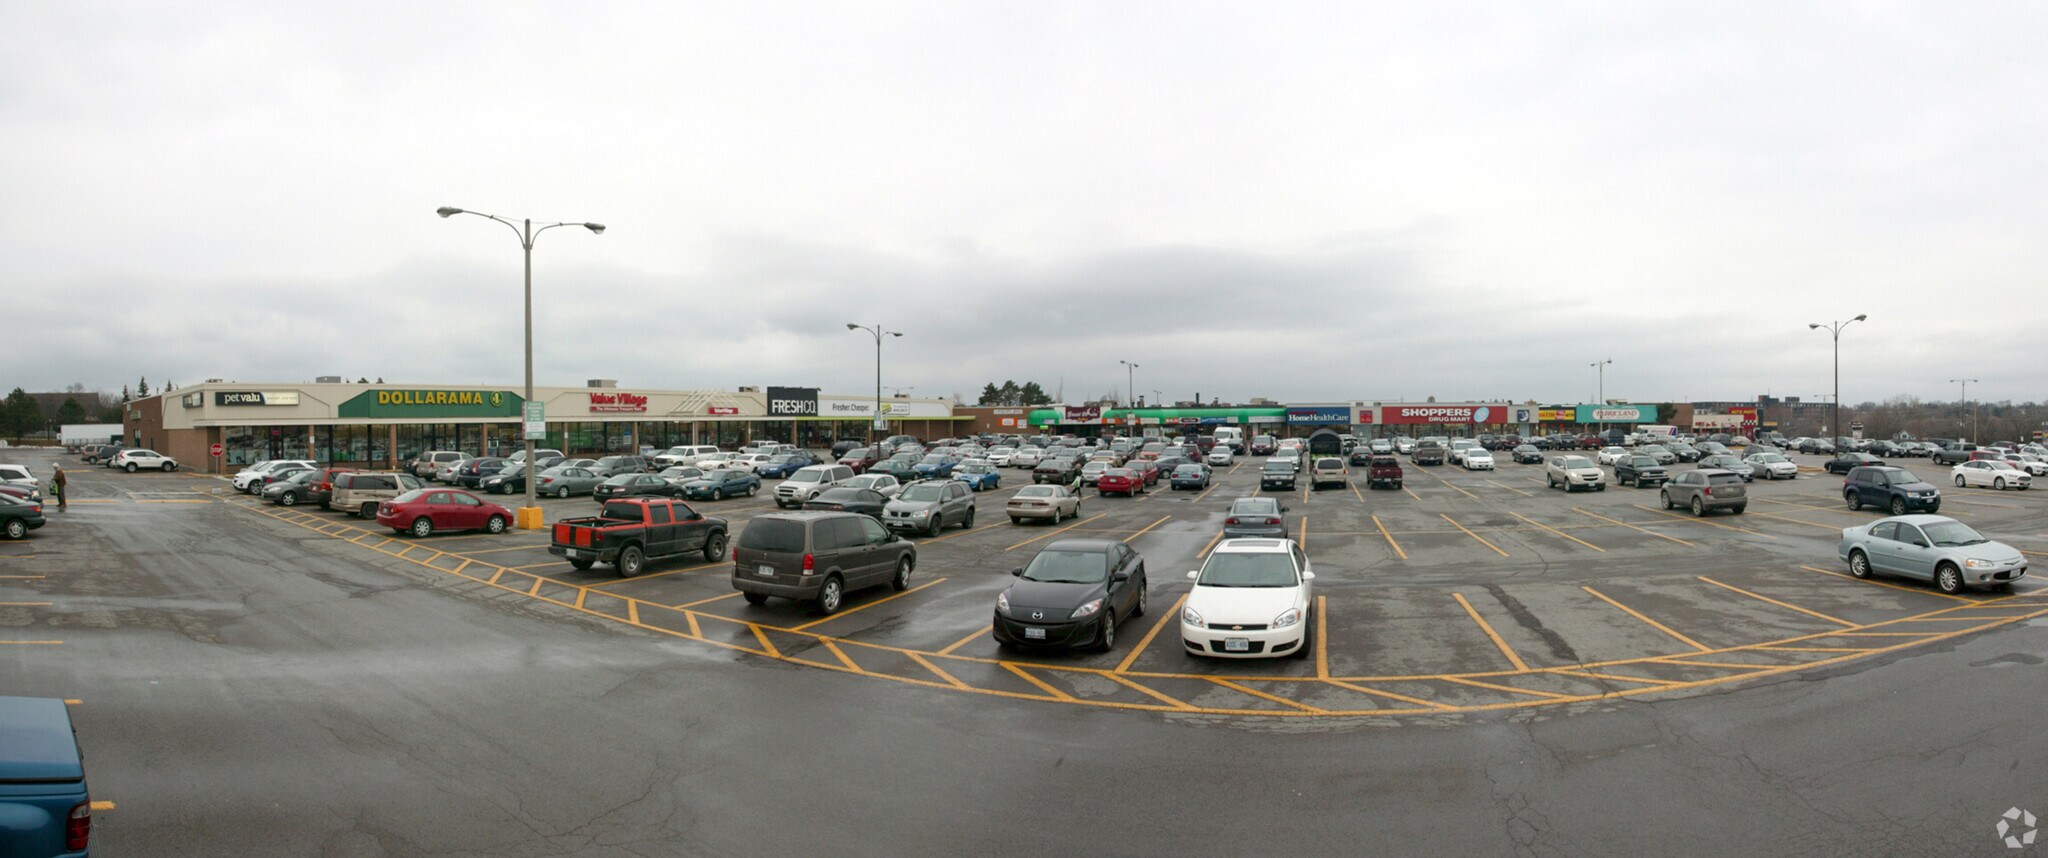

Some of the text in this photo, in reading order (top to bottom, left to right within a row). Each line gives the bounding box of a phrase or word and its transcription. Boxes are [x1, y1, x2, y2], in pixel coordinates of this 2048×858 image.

[224, 393, 261, 404] pet valu
[378, 391, 483, 404] DOLLARAMA
[589, 393, 648, 407] Value Village
[1401, 408, 1471, 417] SHOPPERS
